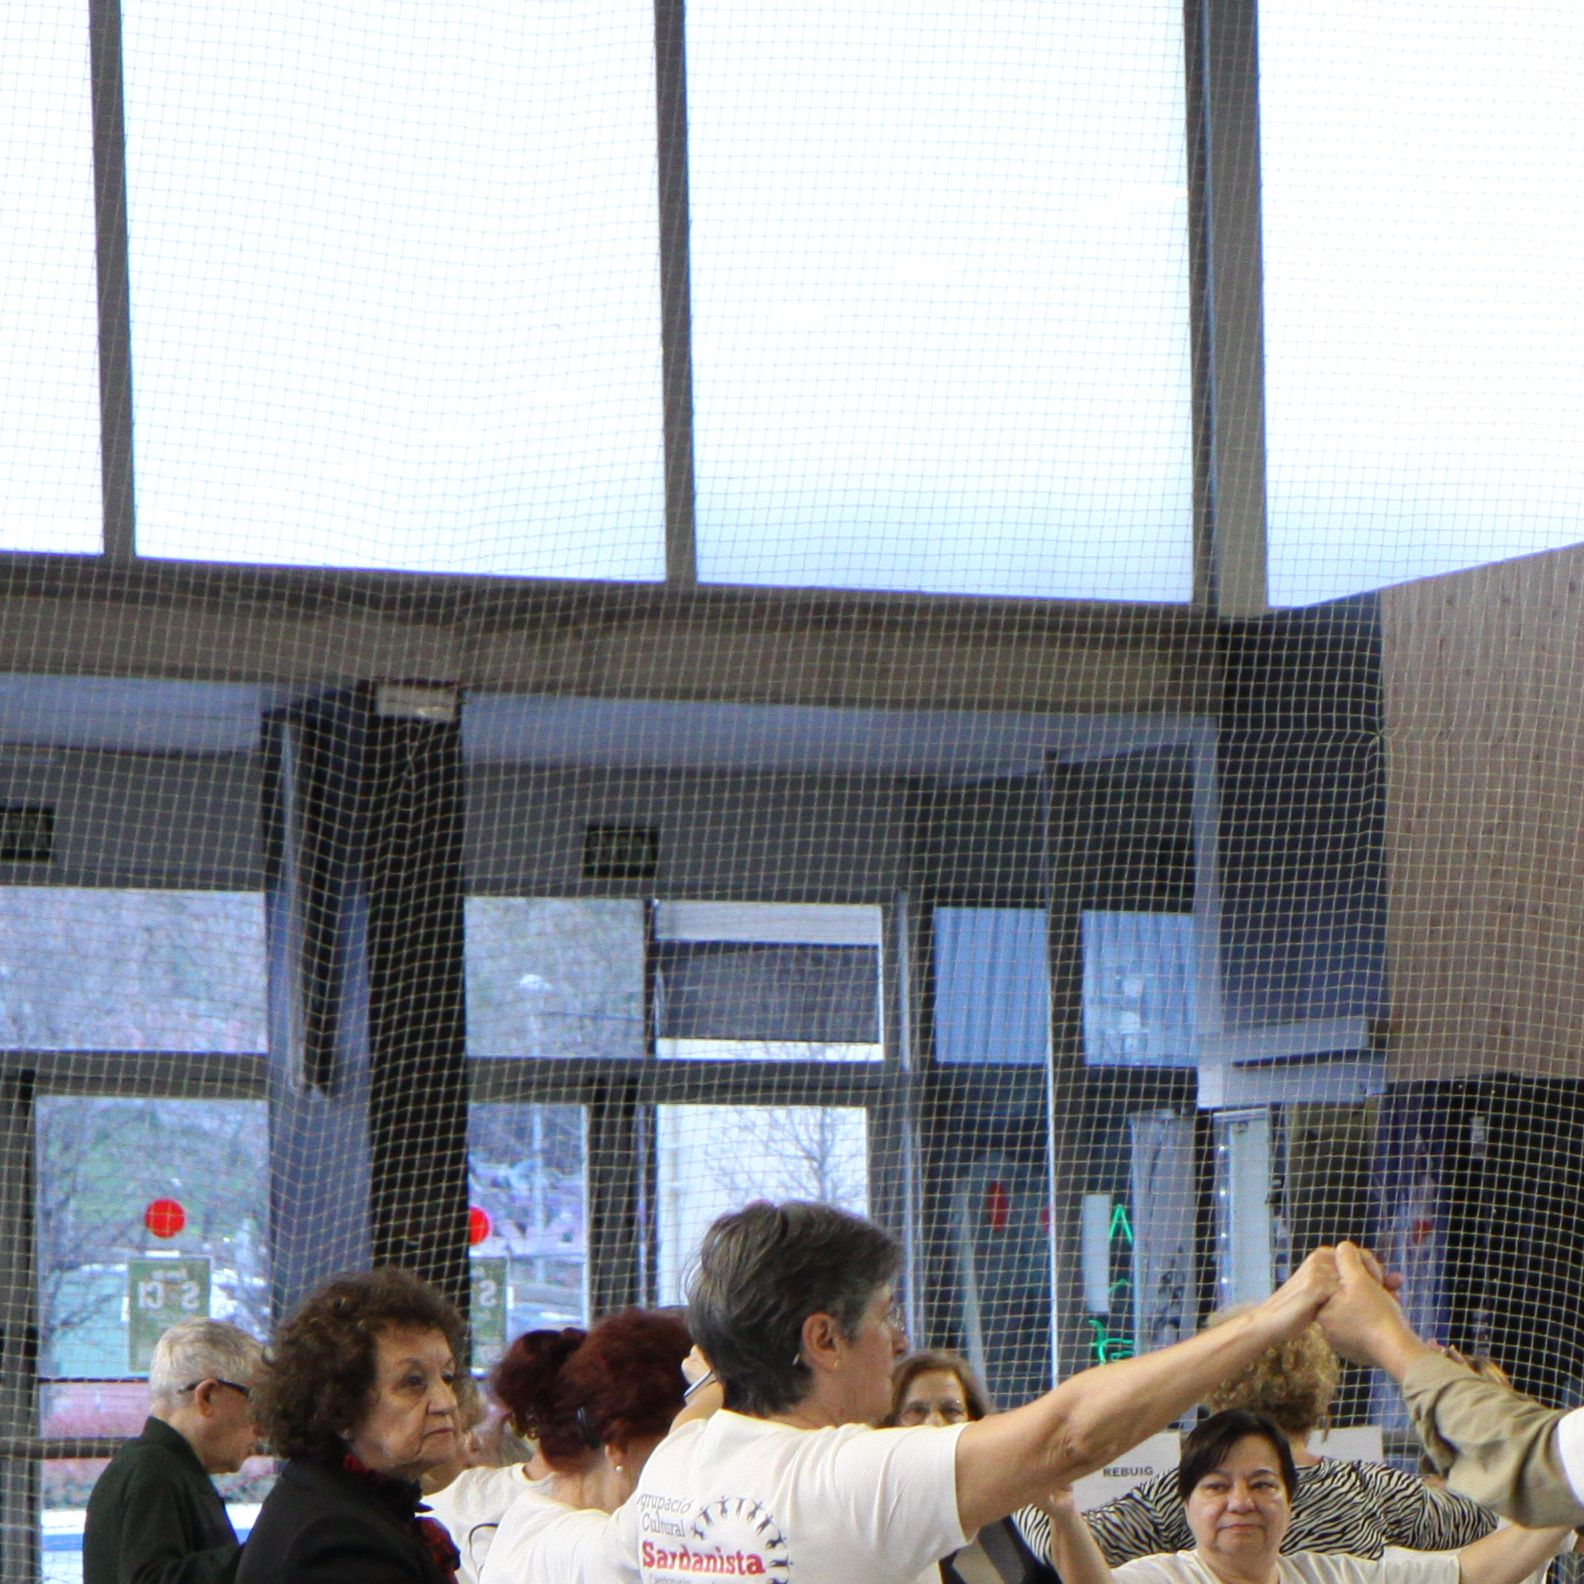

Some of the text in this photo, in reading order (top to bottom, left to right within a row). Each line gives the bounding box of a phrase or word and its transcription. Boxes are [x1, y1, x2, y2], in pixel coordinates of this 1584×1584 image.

[1102, 1466, 1154, 1478] REBUIG
[641, 1512, 686, 1538] Cultural
[641, 1539, 767, 1576] Sardanista
